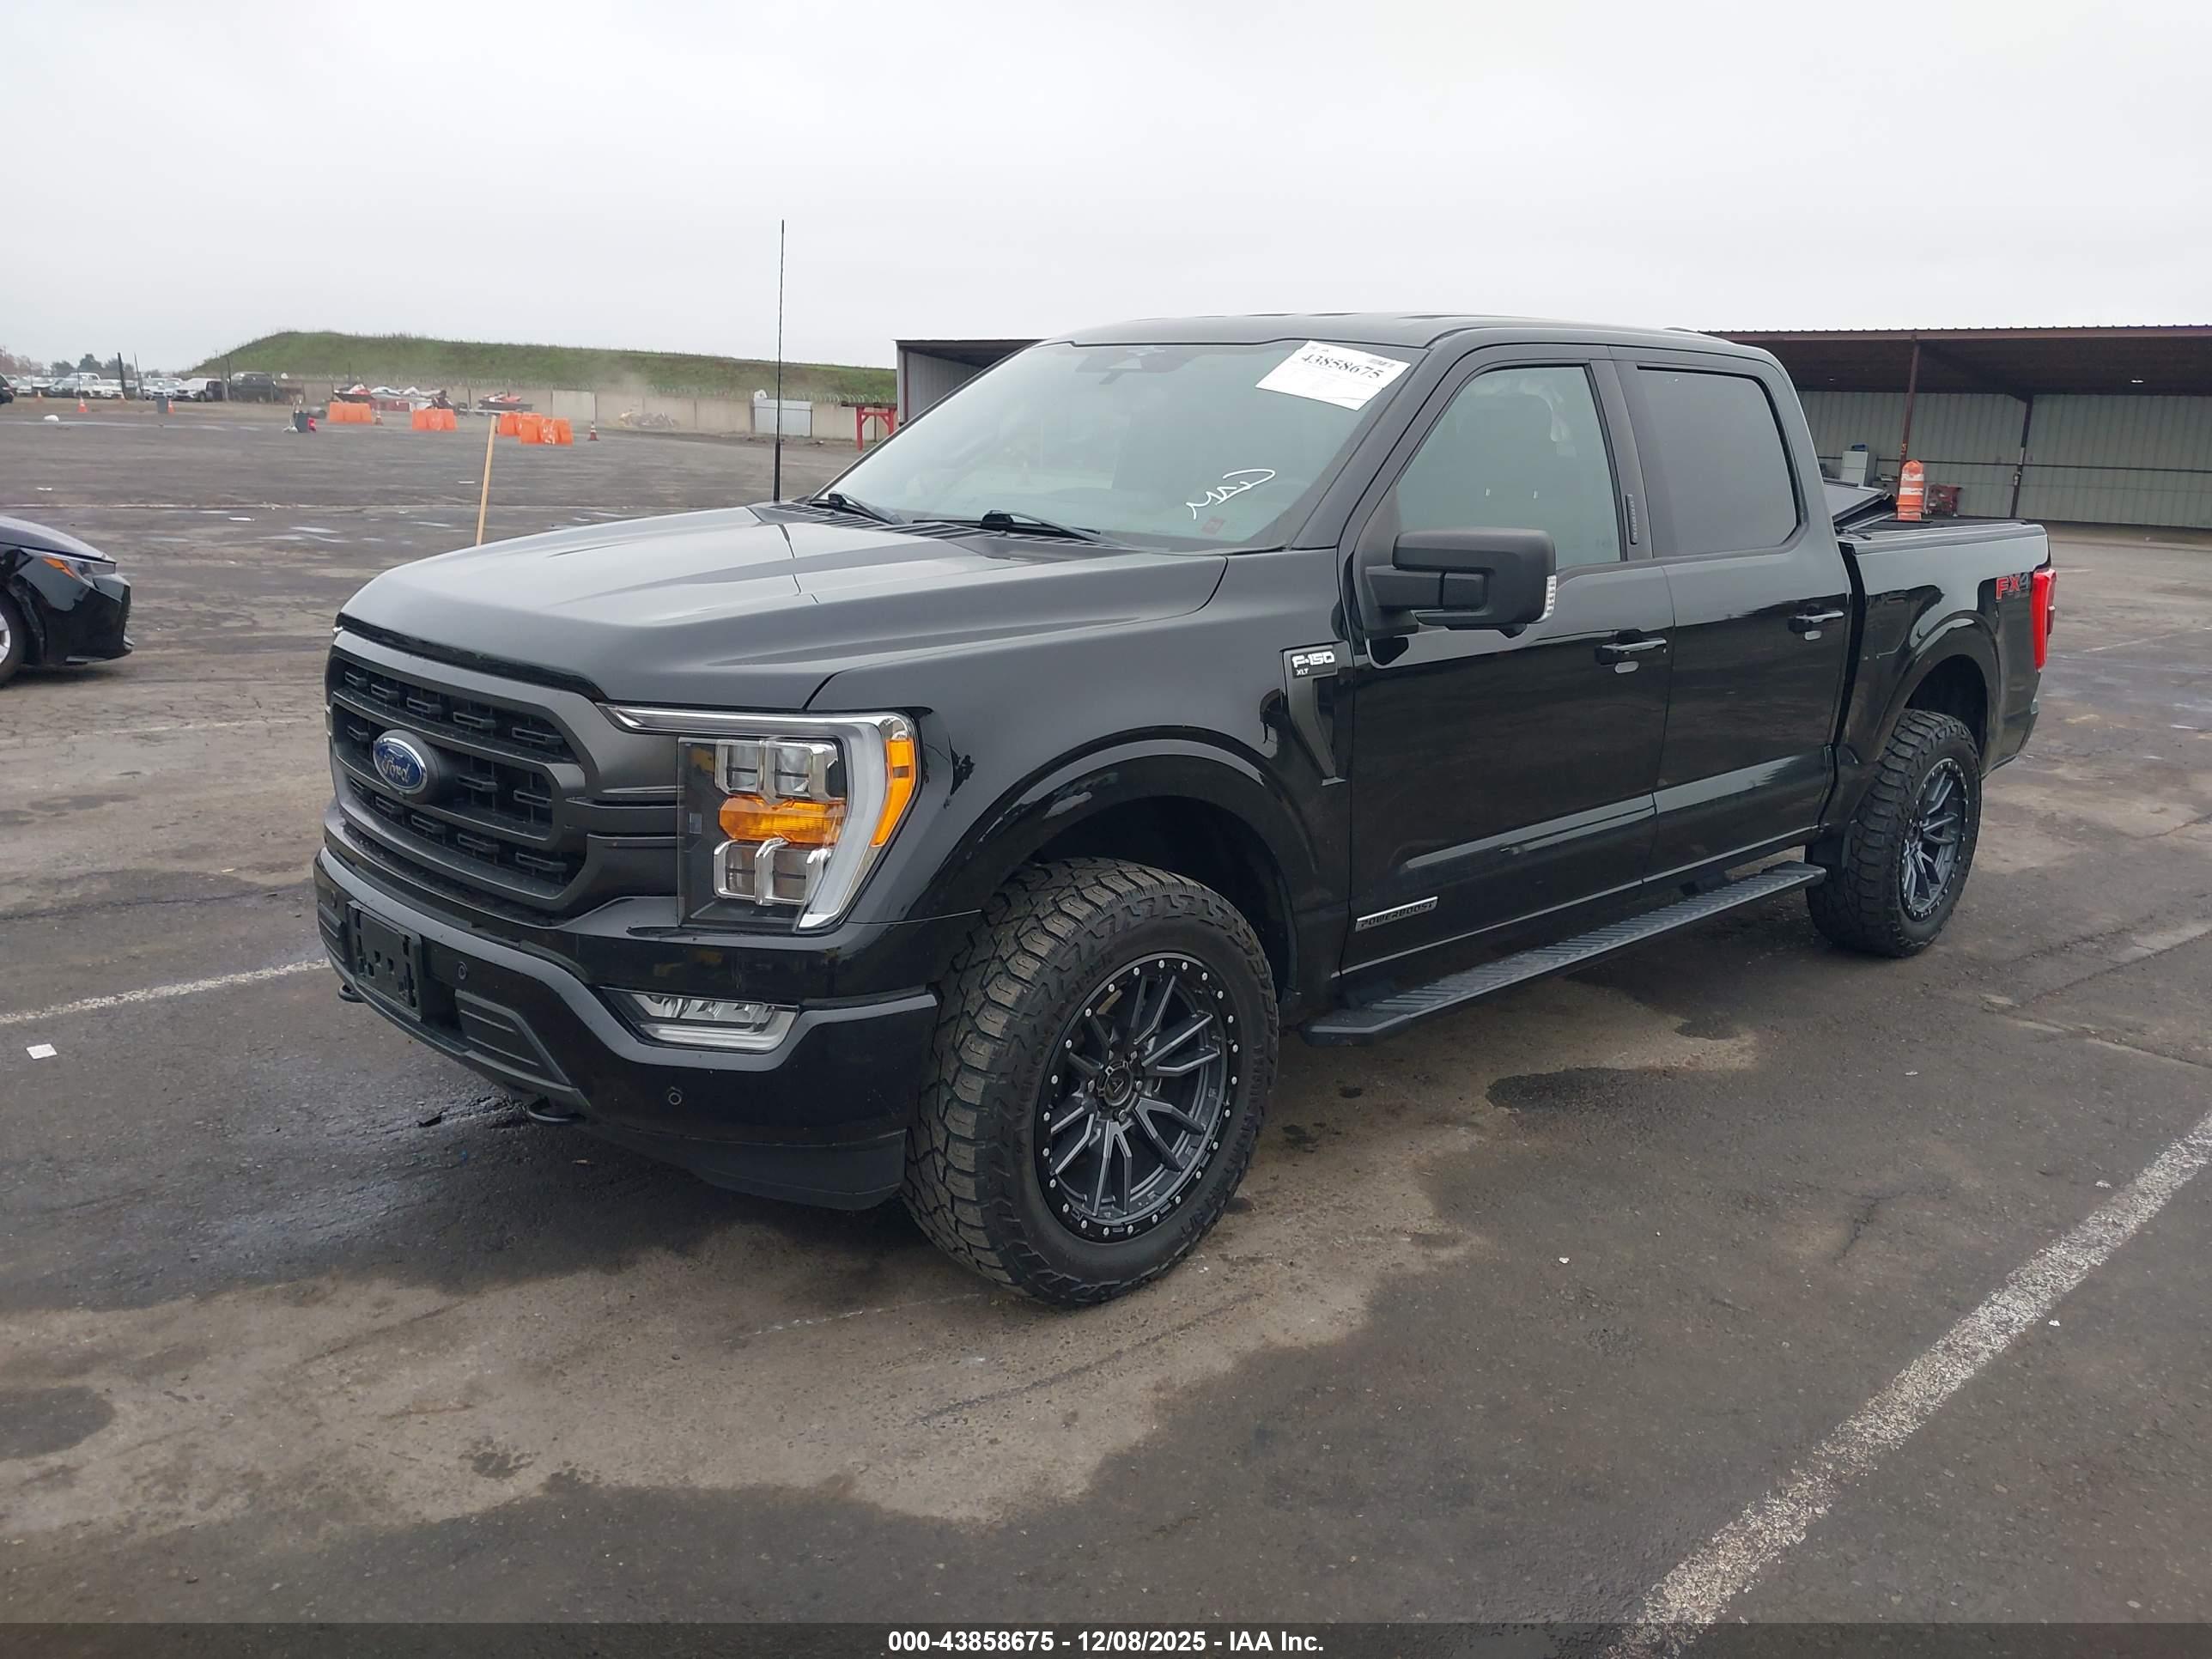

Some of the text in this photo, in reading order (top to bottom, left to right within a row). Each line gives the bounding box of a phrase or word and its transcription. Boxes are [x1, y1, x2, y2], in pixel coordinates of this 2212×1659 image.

[1302, 354, 1383, 378] 43858675
[1996, 572, 2030, 599] FX4
[1291, 651, 1335, 668] F-150
[381, 748, 410, 783] Ford
